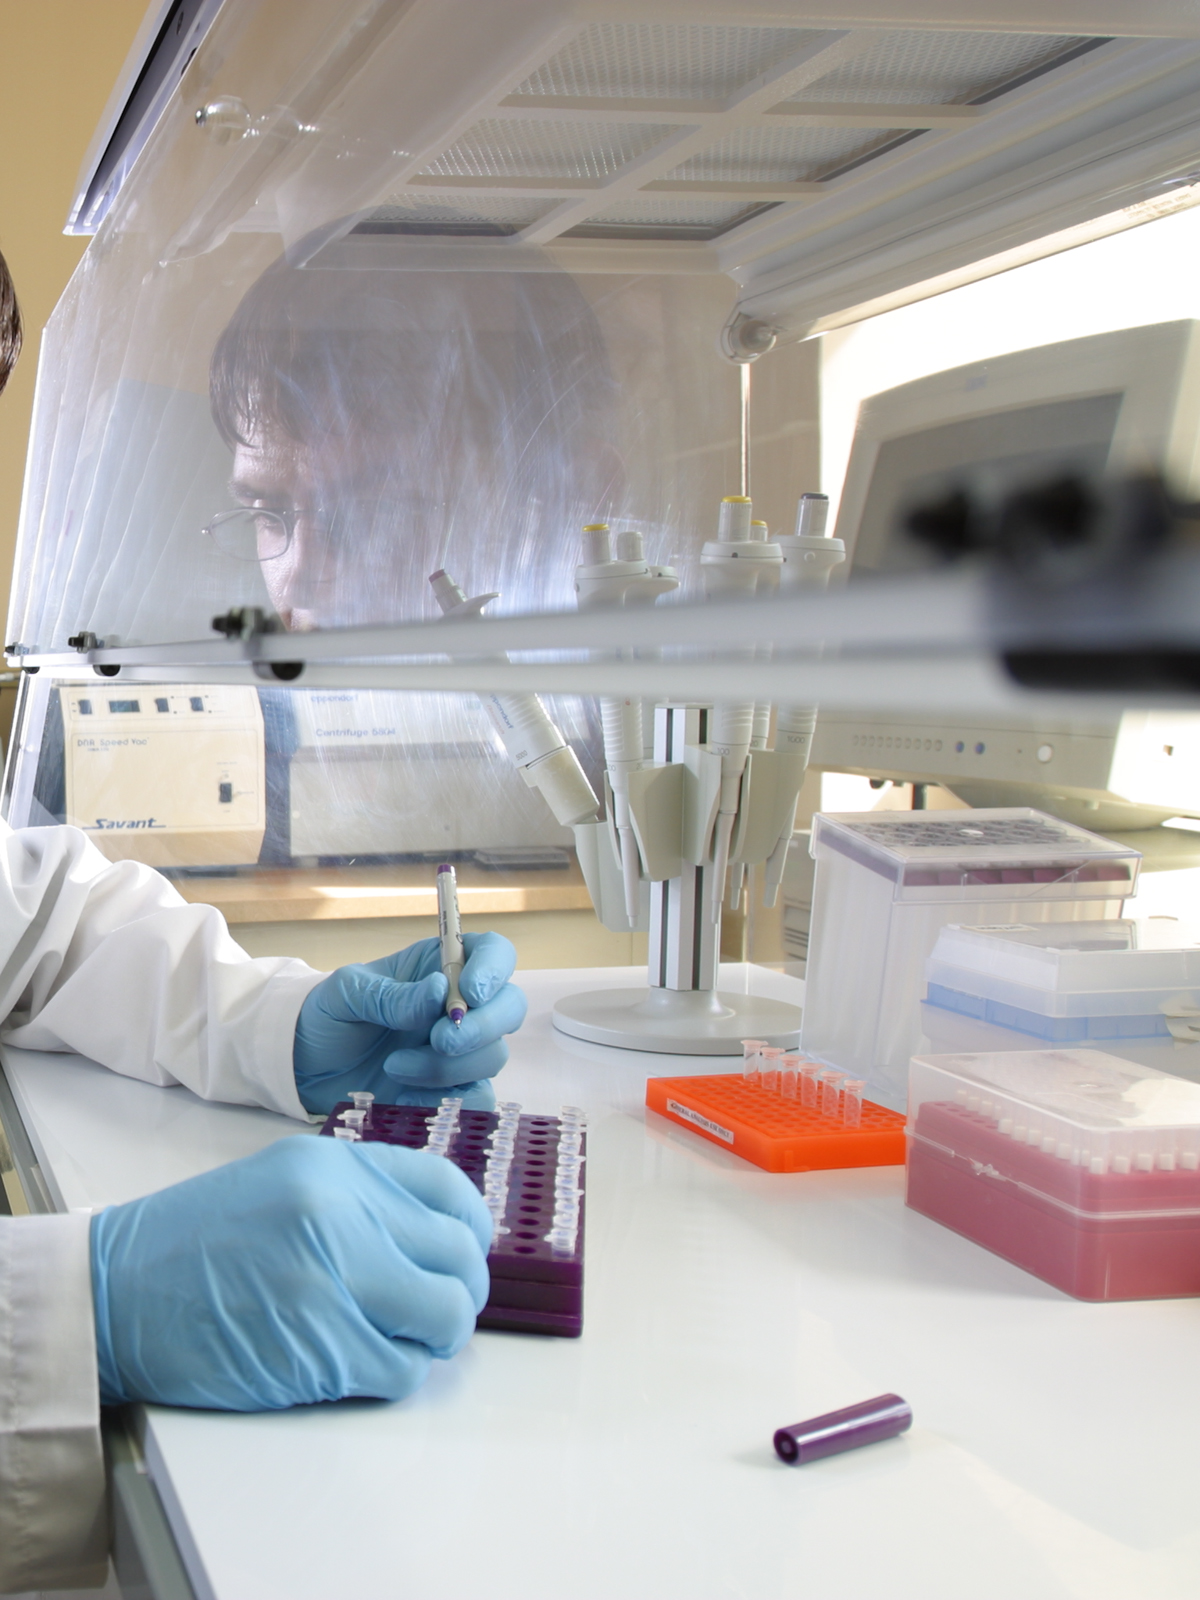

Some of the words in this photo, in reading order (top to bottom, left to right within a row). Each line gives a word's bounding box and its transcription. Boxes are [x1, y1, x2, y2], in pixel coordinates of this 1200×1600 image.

[315, 728, 369, 738] Centrifuge
[77, 739, 95, 747] DNA
[100, 738, 129, 746] Speed
[92, 817, 160, 830] Savant
